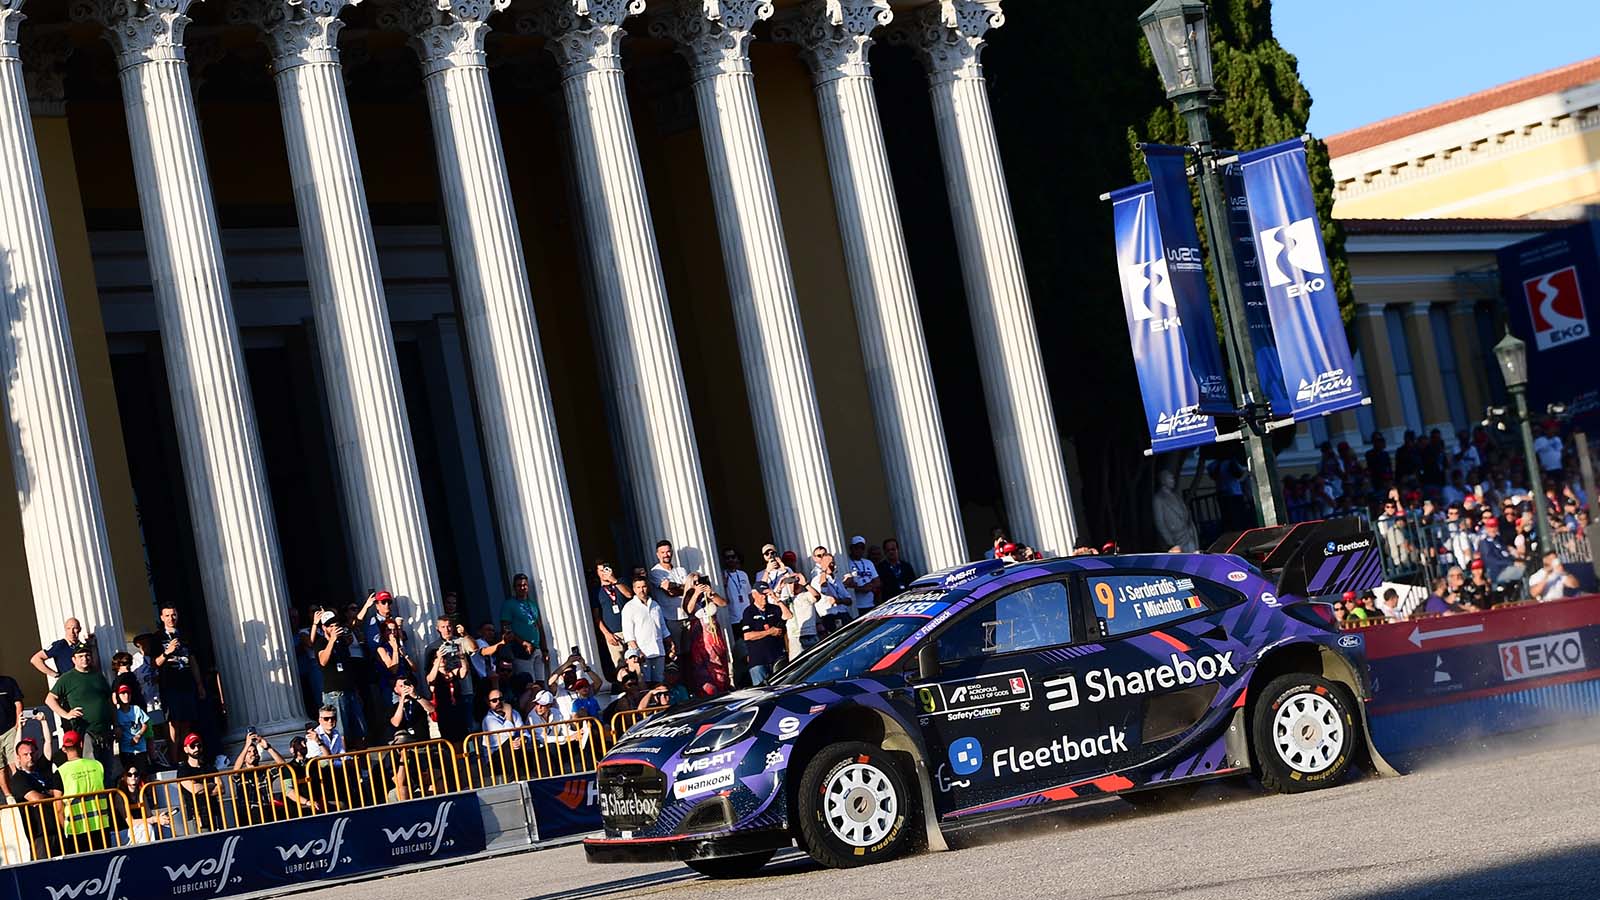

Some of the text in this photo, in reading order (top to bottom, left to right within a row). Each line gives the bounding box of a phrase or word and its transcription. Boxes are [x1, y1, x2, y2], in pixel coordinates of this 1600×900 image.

[1287, 278, 1325, 298] EKO
[1150, 316, 1182, 332] EK
[1550, 324, 1585, 343] EKO
[1337, 538, 1370, 552] Fleetback
[1095, 582, 1115, 619] 9
[1119, 578, 1177, 603] J Serderidis
[1133, 597, 1184, 619] F Miclotte
[921, 611, 952, 635] Fleetback
[1526, 638, 1581, 670] EKO
[1085, 651, 1237, 703] Sharebox
[919, 688, 935, 712] 9
[947, 707, 1001, 721] SafetyCulture
[992, 726, 1128, 777] Fleetback
[608, 792, 659, 816] Sharebox
[382, 800, 454, 856] wolf
[275, 817, 350, 873] wolf
[392, 842, 433, 856] LUBRICANTS
[163, 835, 241, 894] wolf
[285, 858, 328, 874] LUBRICANTS
[173, 879, 217, 895] LUBRICANTS
